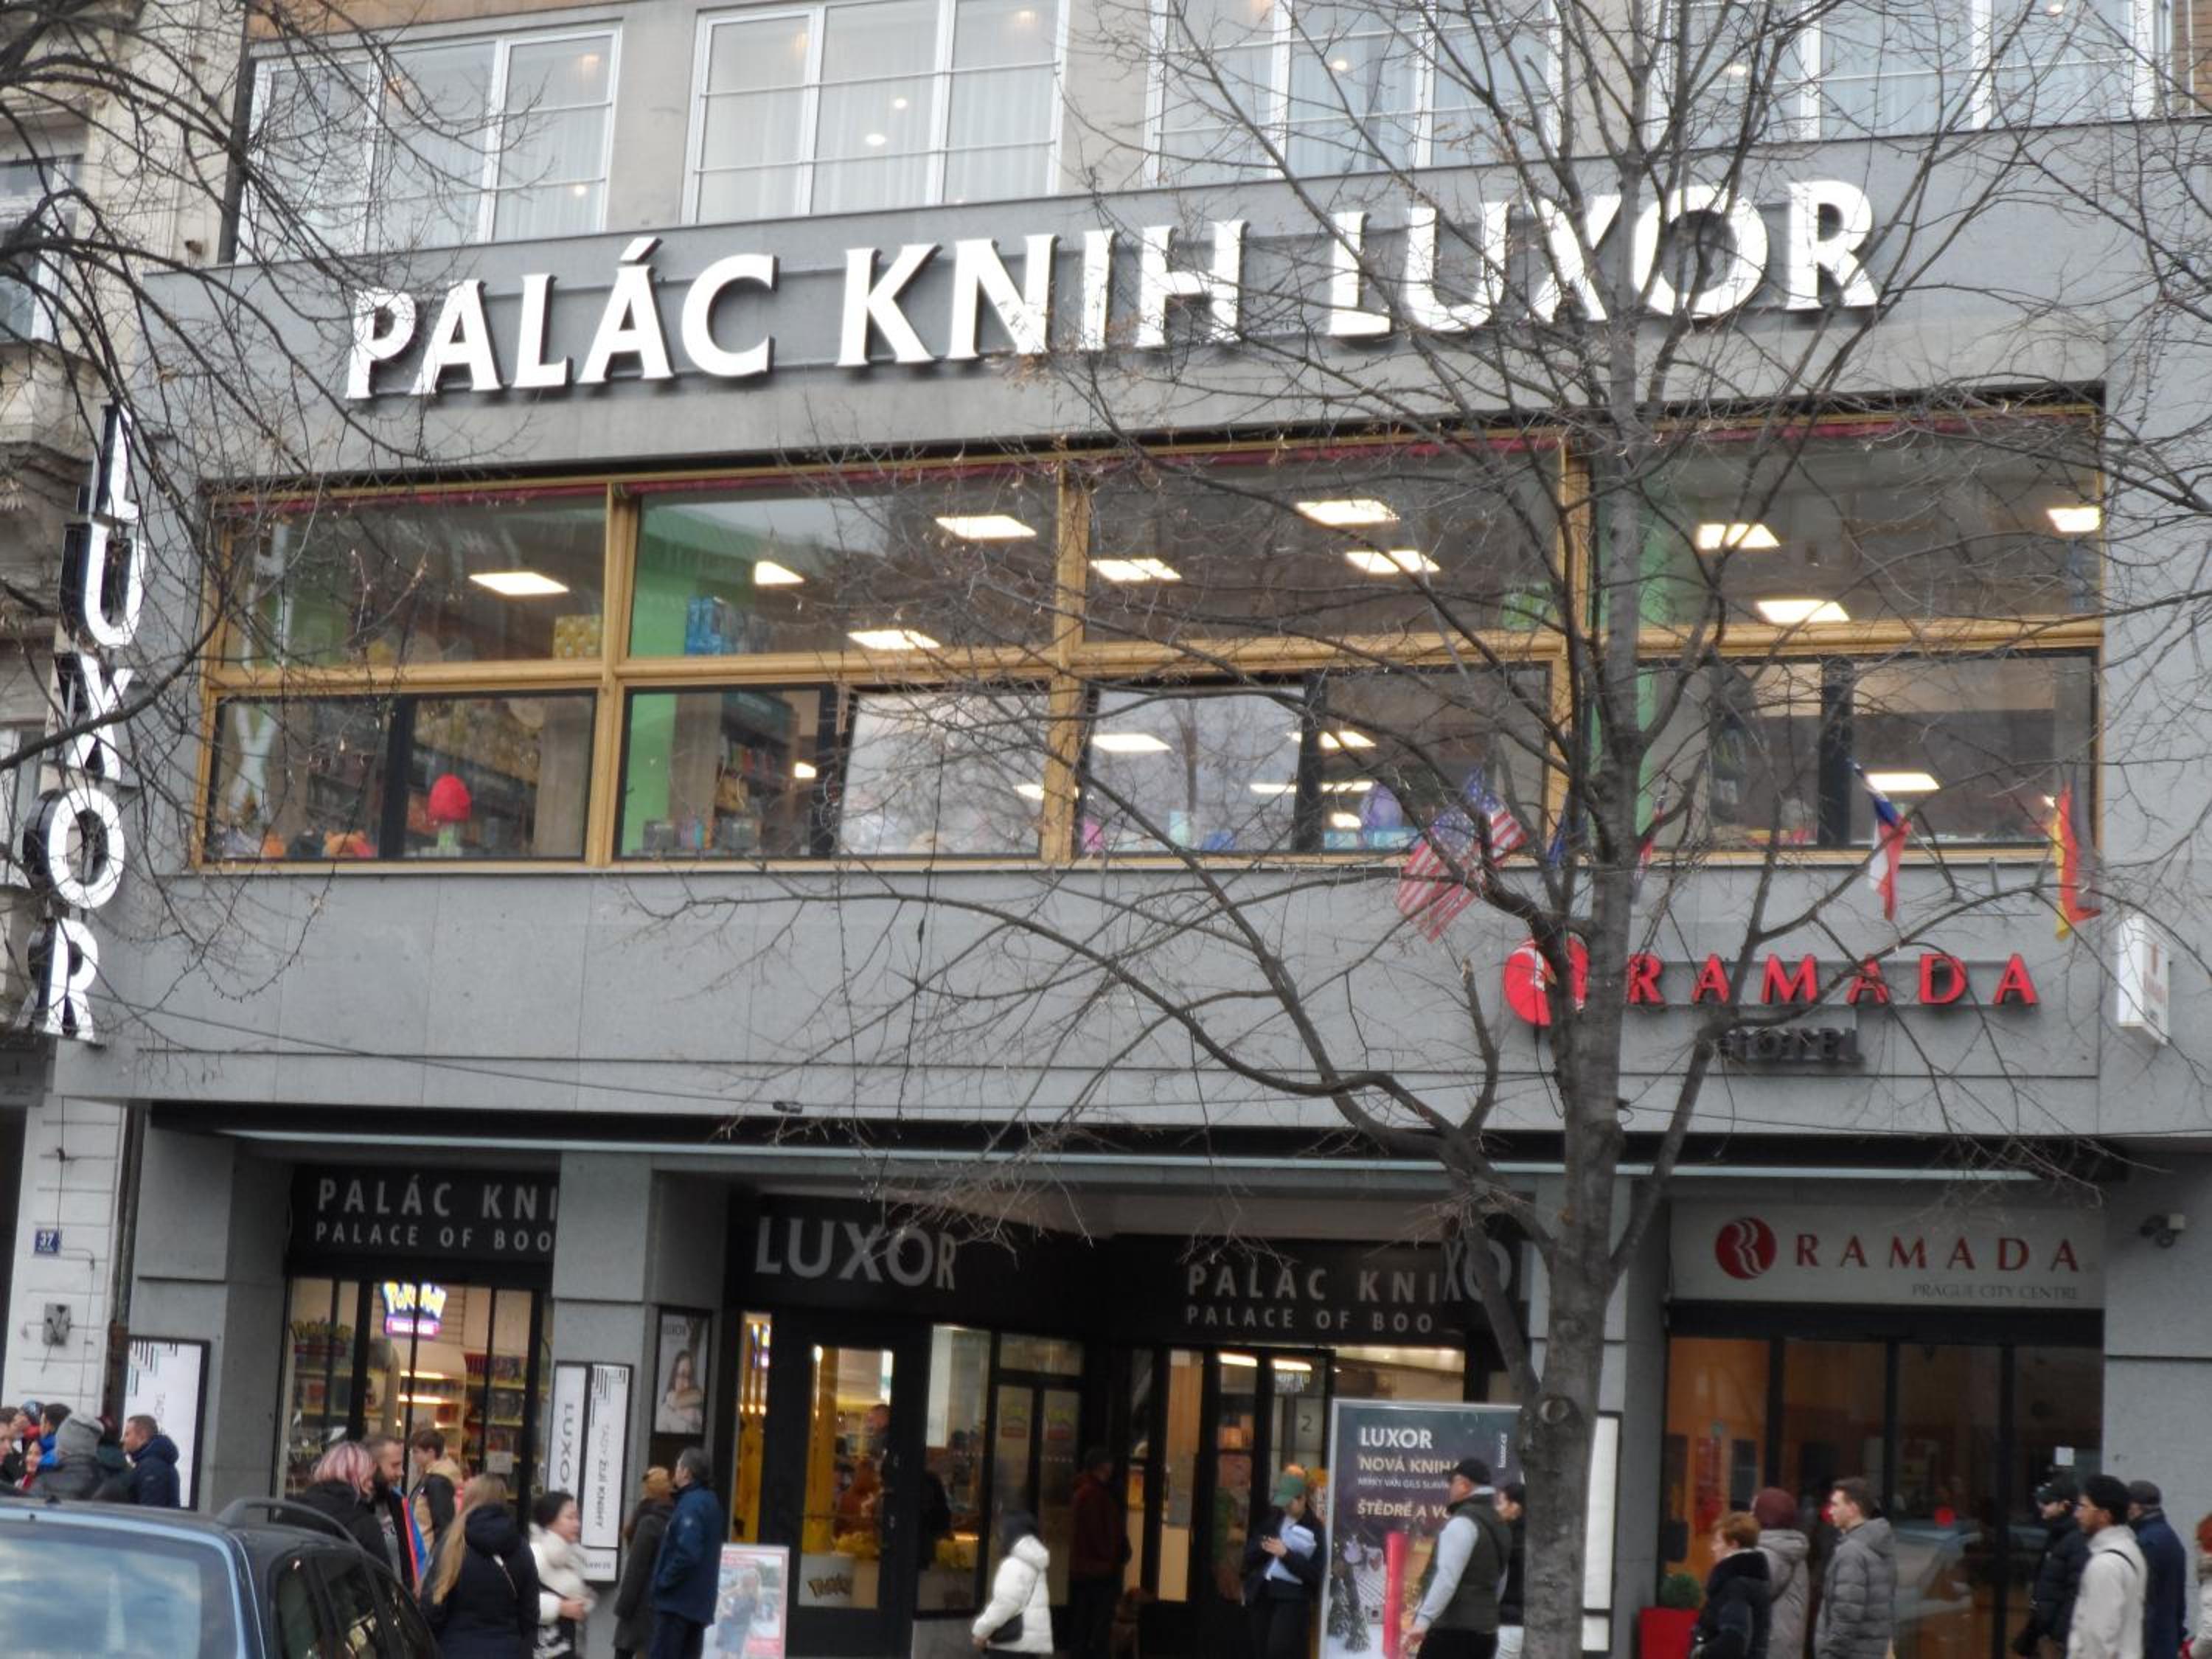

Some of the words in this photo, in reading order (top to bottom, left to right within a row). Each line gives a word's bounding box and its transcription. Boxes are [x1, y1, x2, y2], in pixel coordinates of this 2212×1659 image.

[344, 236, 778, 400] PALÁC
[836, 220, 1248, 366] KNIH
[1328, 181, 1880, 336] LUXOR
[26, 404, 147, 1041] LUXOR
[1626, 951, 2039, 1006] RAMADA
[318, 1172, 452, 1217] PALÁC
[481, 1183, 557, 1222] KNI
[316, 1221, 418, 1246] PALACE
[439, 1226, 473, 1249] OF
[493, 1228, 552, 1252] BOO
[754, 1216, 957, 1291] LUXOR
[1795, 1233, 2081, 1273] RAMADA
[1187, 1259, 1326, 1301] PALÁC
[1187, 1304, 1294, 1328] PALACE
[1316, 1310, 1350, 1329] OF
[1372, 1312, 1433, 1333] BOO
[1360, 1427, 1433, 1450] LUXOR
[1359, 1454, 1405, 1472] NOVÁ
[1357, 1498, 1414, 1517] ŠTĚDRÉ
[1415, 1504, 1427, 1518] A
